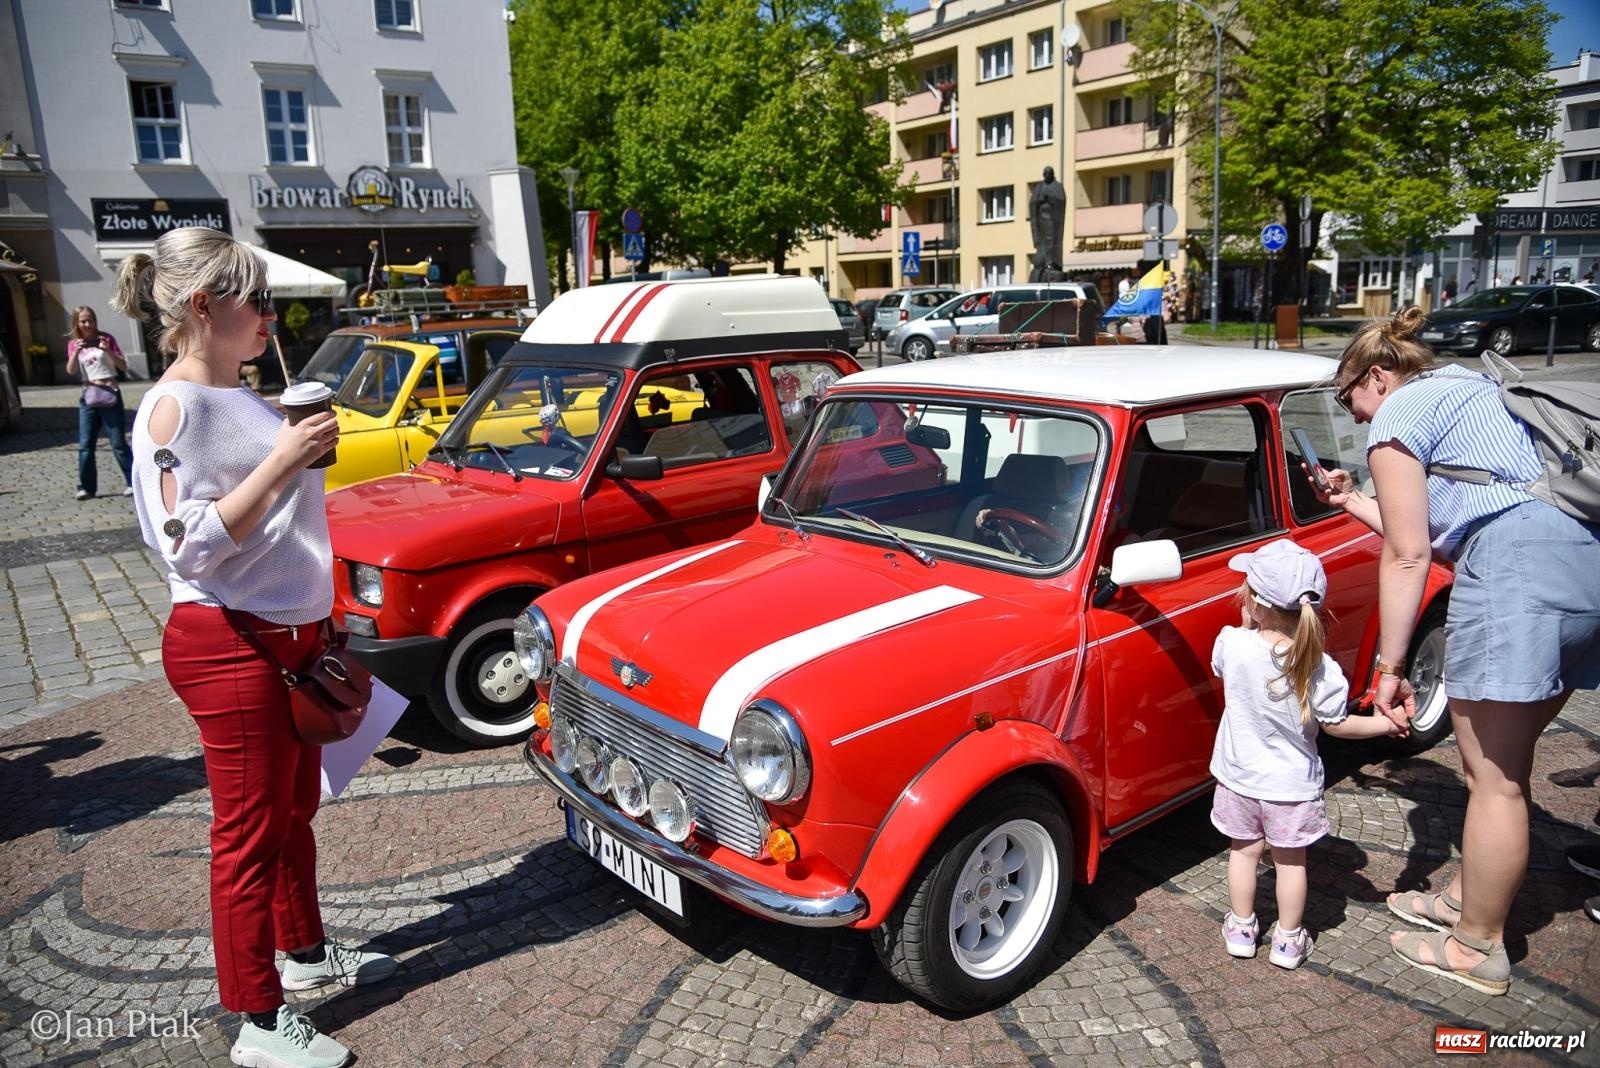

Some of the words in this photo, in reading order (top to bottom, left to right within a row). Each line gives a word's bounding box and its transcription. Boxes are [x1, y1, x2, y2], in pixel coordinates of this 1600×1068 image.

[249, 175, 342, 209] Browar
[399, 176, 475, 213] Rynek
[101, 213, 148, 230] Złote
[1553, 213, 1598, 228] DANCE
[611, 838, 667, 905] MINI
